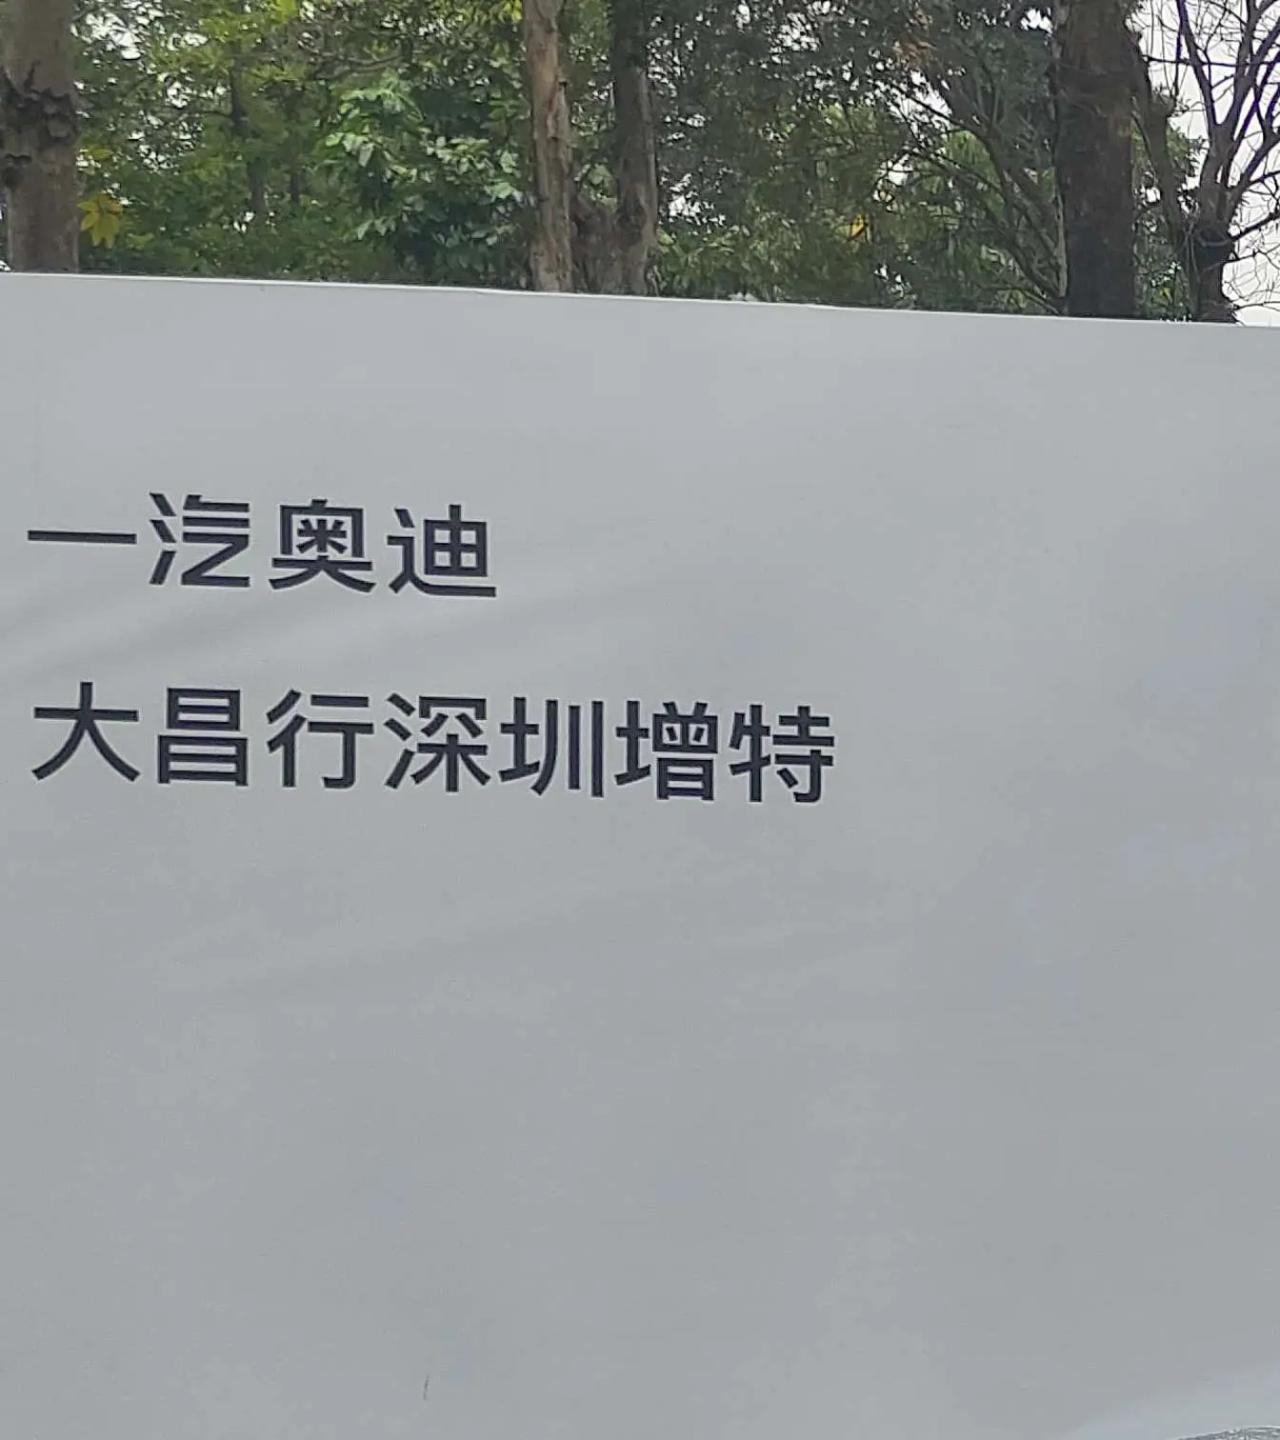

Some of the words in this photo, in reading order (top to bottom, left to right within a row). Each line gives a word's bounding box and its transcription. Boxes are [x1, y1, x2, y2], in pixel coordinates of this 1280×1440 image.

[27, 492, 497, 598] 一汽奥迪
[32, 681, 837, 803] 大昌行深圳增特
